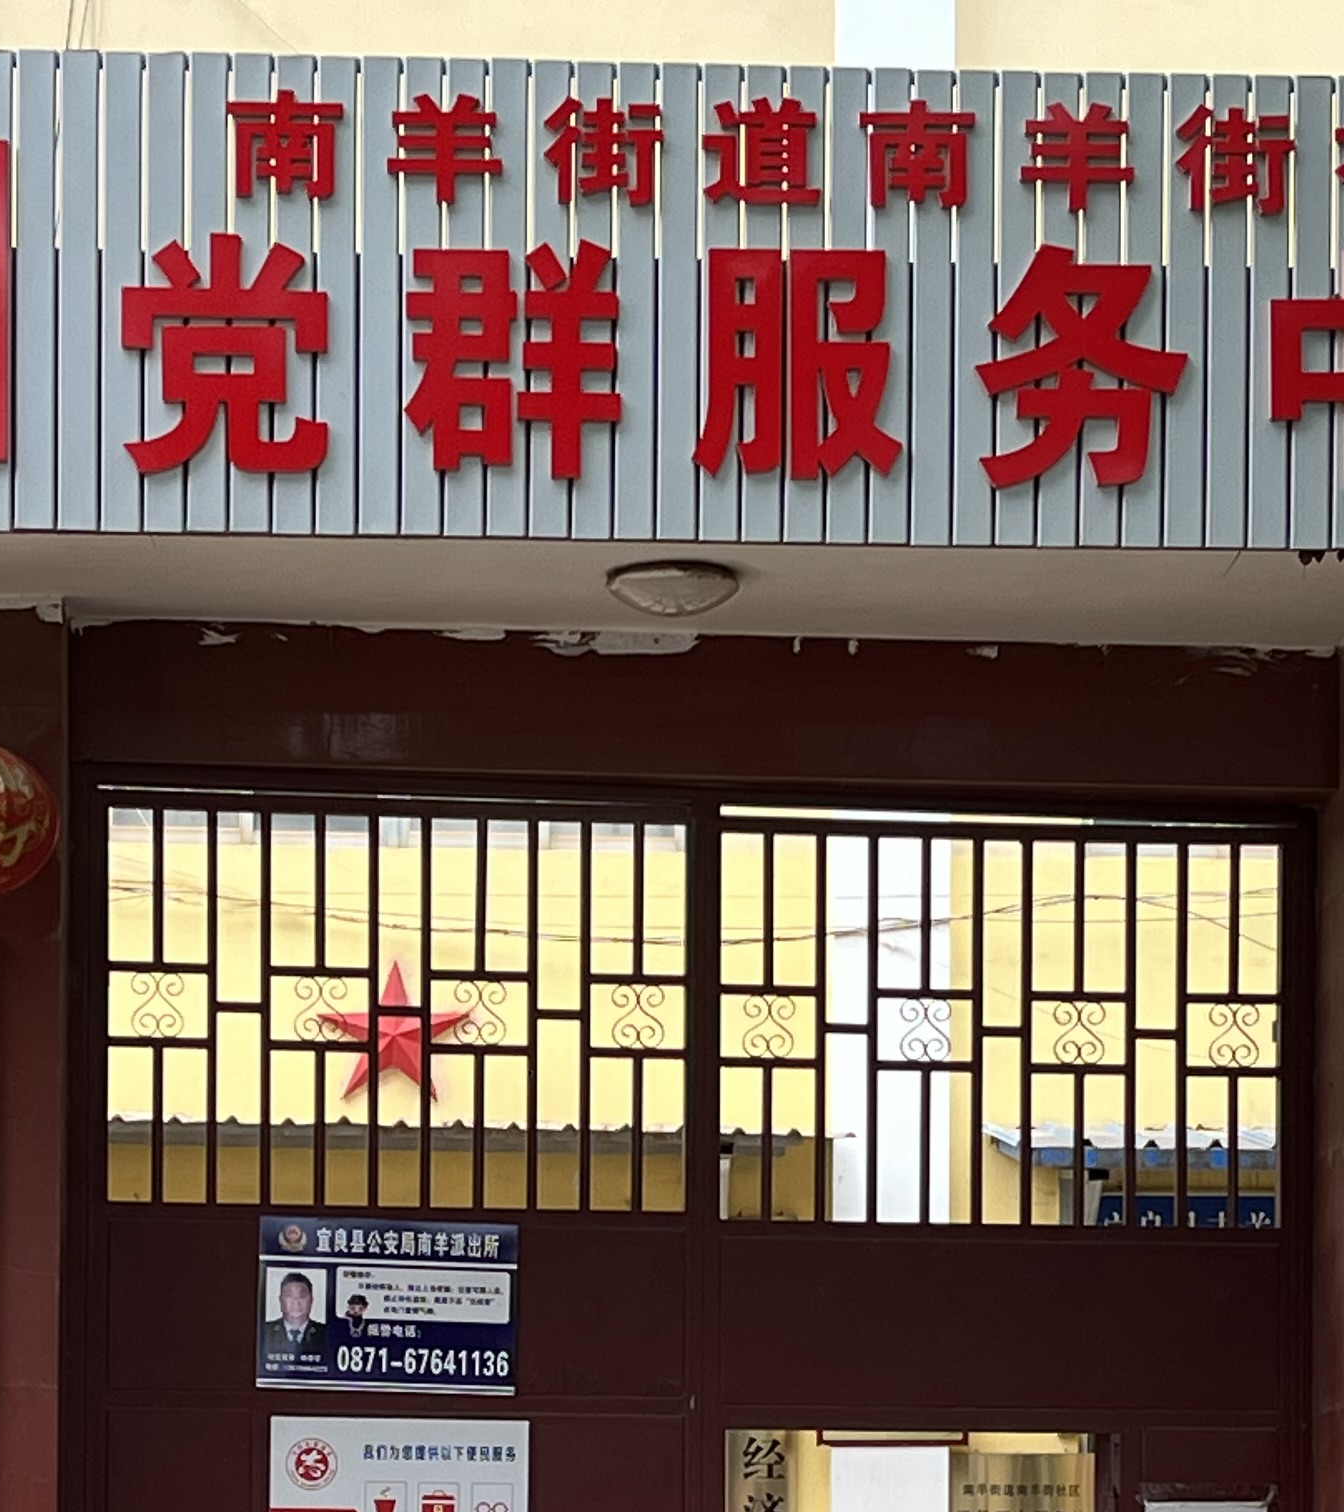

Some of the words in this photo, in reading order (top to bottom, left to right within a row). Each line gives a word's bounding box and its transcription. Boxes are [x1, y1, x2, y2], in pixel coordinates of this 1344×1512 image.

[315, 1226, 501, 1260] 宜良县公安局南羊派出所
[337, 1345, 510, 1377] 0871-67641136
[363, 1444, 516, 1462] 我们为您提供以下便民服务
